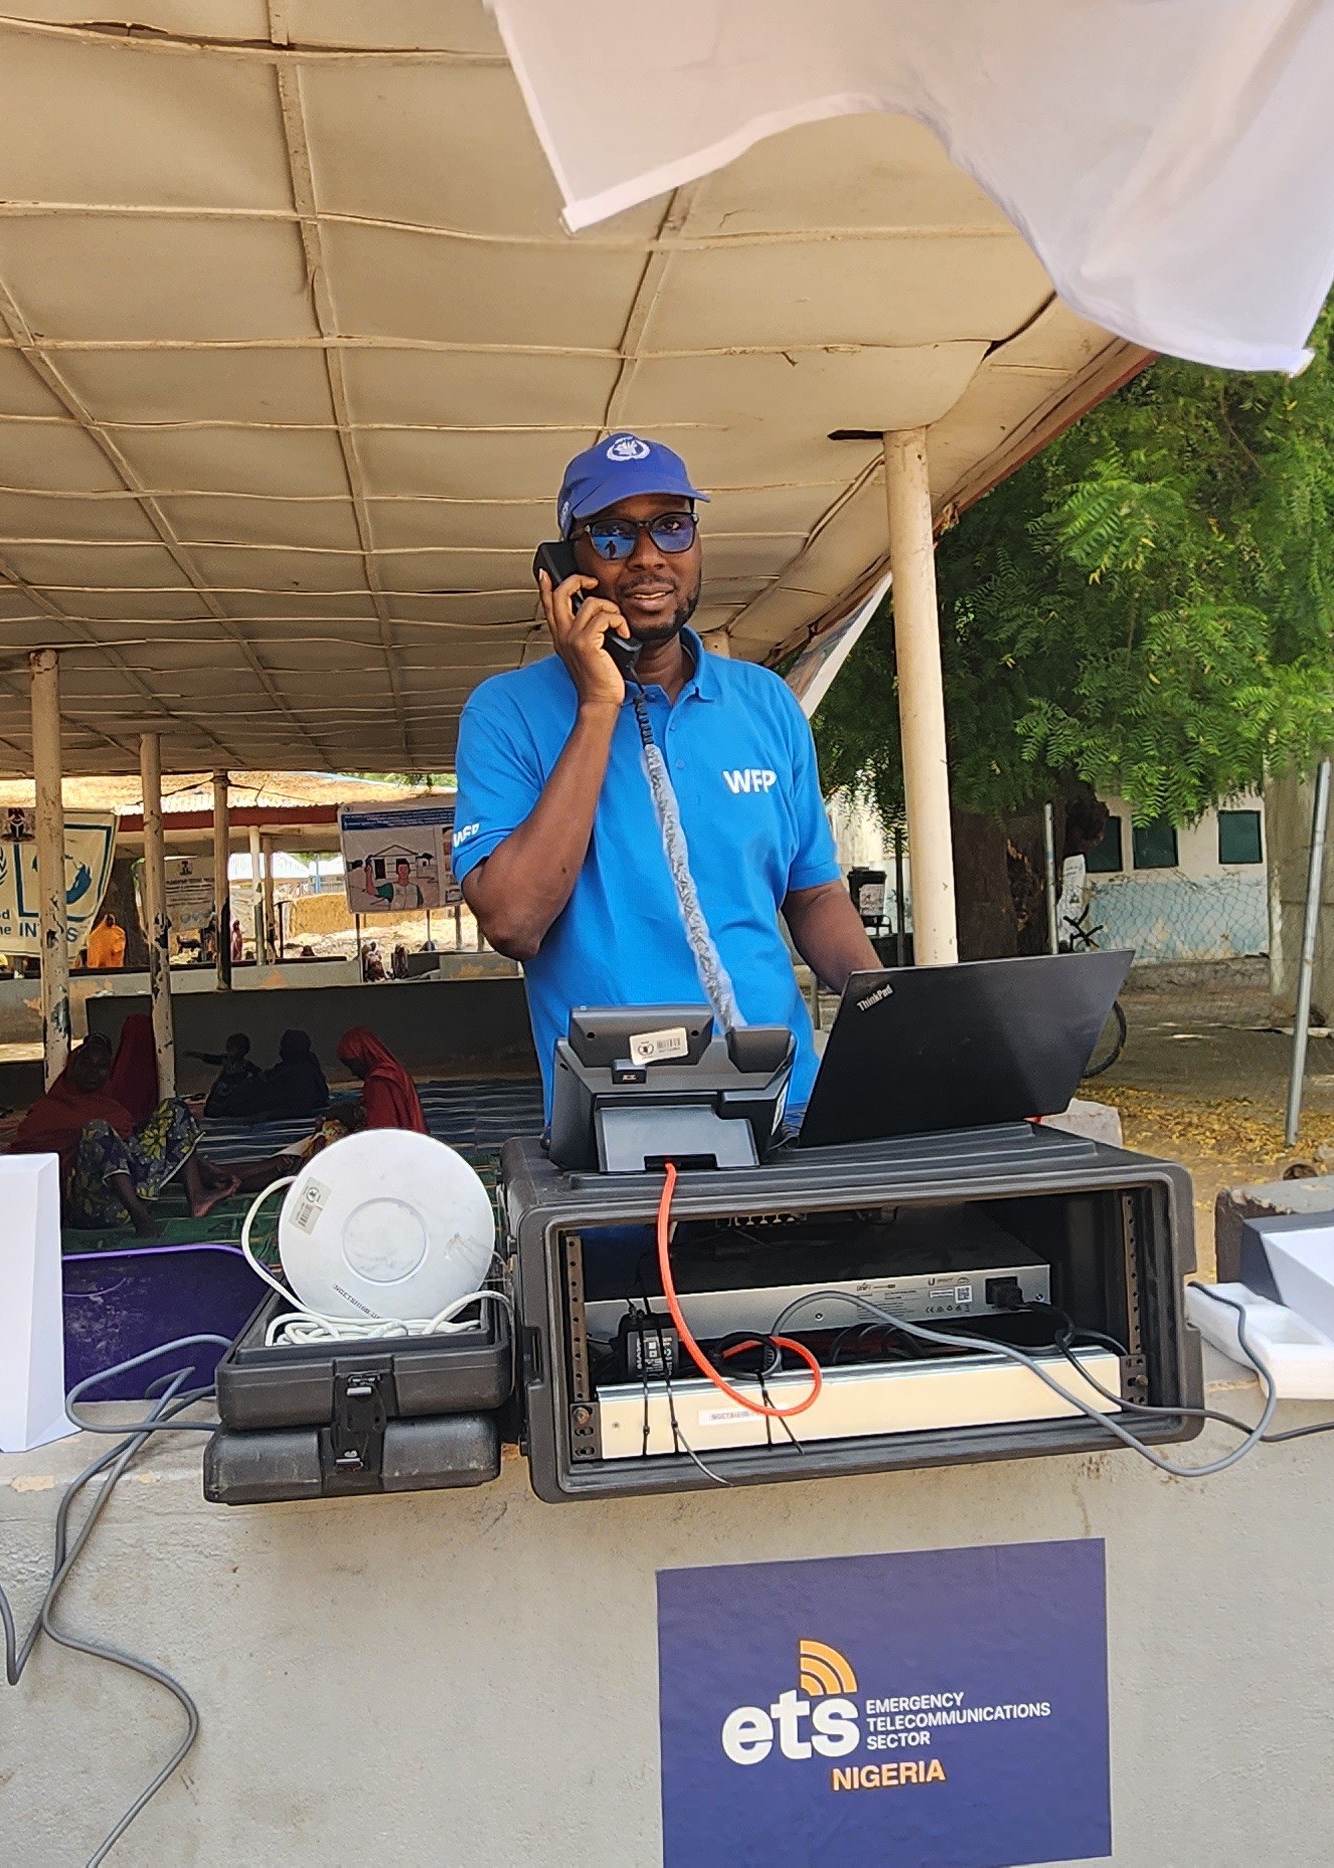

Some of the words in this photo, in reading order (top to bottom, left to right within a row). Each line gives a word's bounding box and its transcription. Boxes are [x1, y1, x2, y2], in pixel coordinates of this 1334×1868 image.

[722, 768, 777, 794] WFP
[453, 823, 480, 848] WFP
[856, 983, 894, 1012] ThinkPad
[866, 1692, 965, 1714] EMERGENCY
[722, 1689, 861, 1765] ets
[866, 1702, 1052, 1732] TELECOMMUNICATIONS
[866, 1731, 931, 1750] SECTOR
[831, 1759, 947, 1792] NIGERIA
